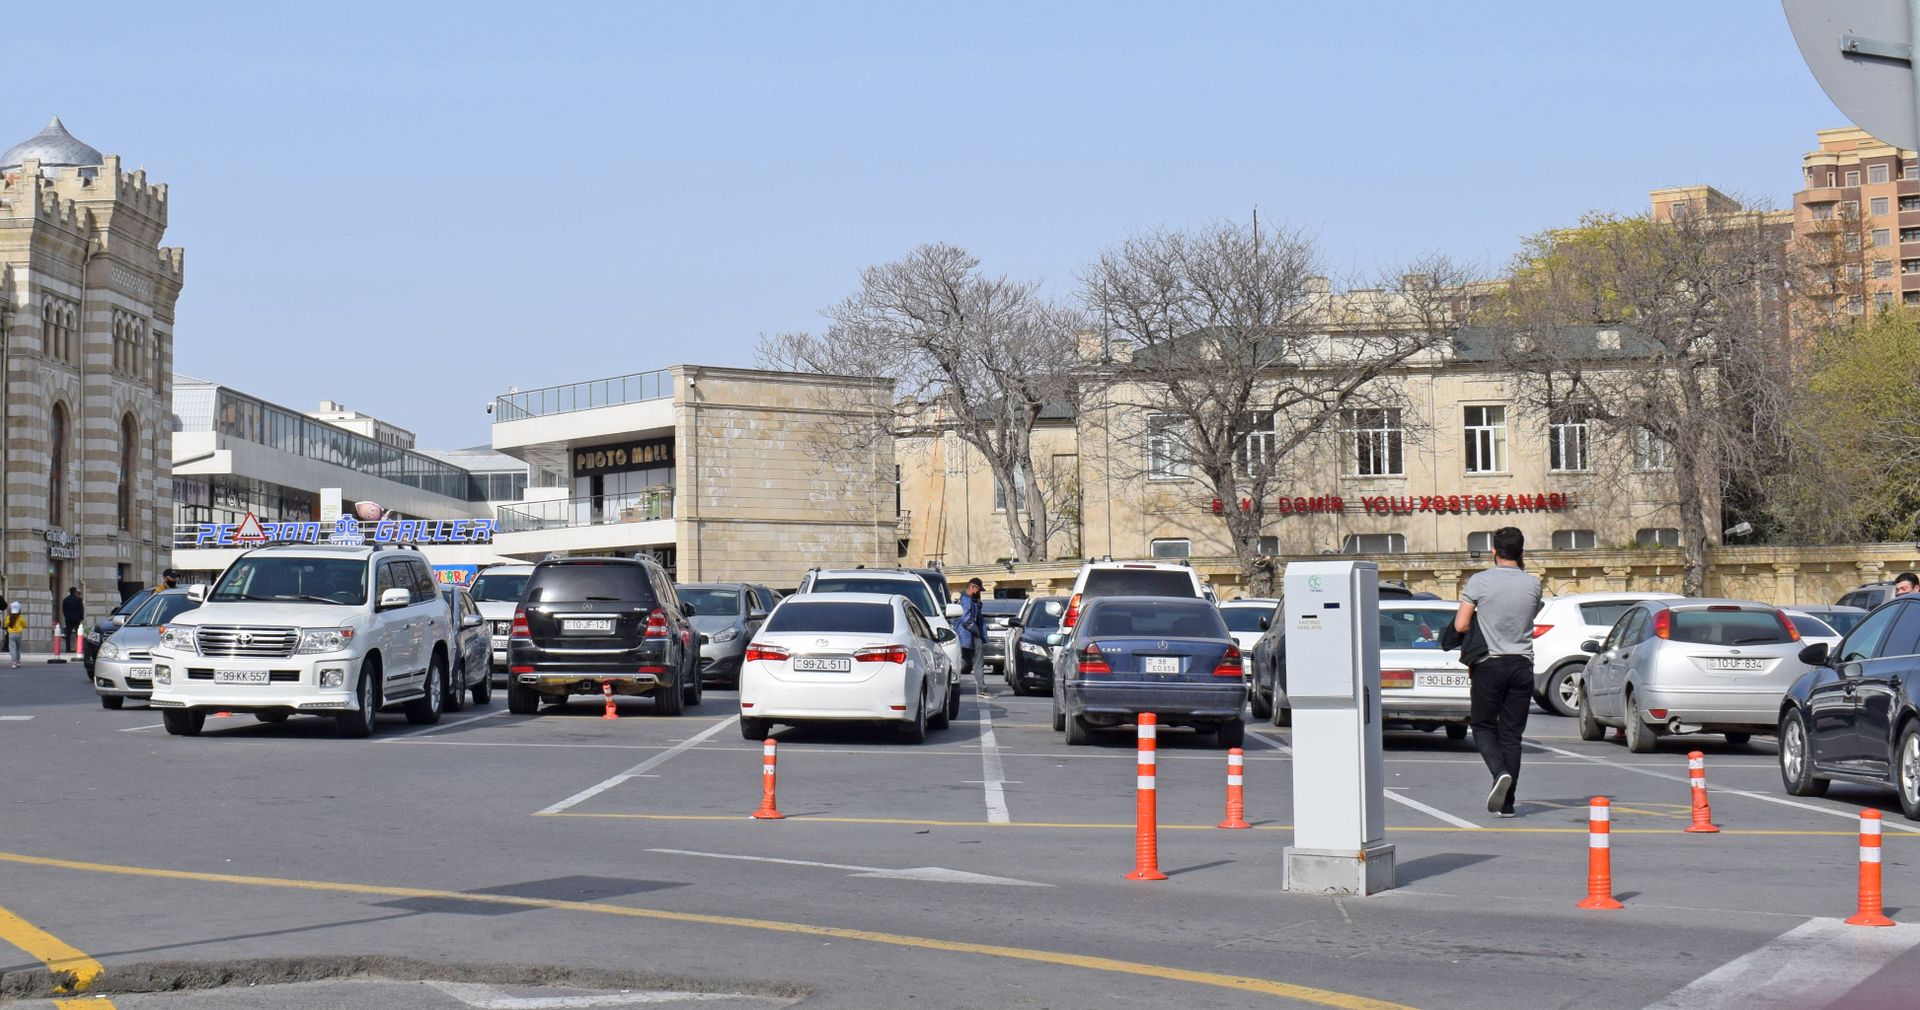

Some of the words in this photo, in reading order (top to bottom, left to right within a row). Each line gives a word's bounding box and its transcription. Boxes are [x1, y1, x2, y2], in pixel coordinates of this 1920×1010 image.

[576, 448, 627, 470] PHOTO
[632, 444, 668, 464] MALL
[1361, 496, 1414, 513] YOLU
[196, 522, 321, 546] PERON
